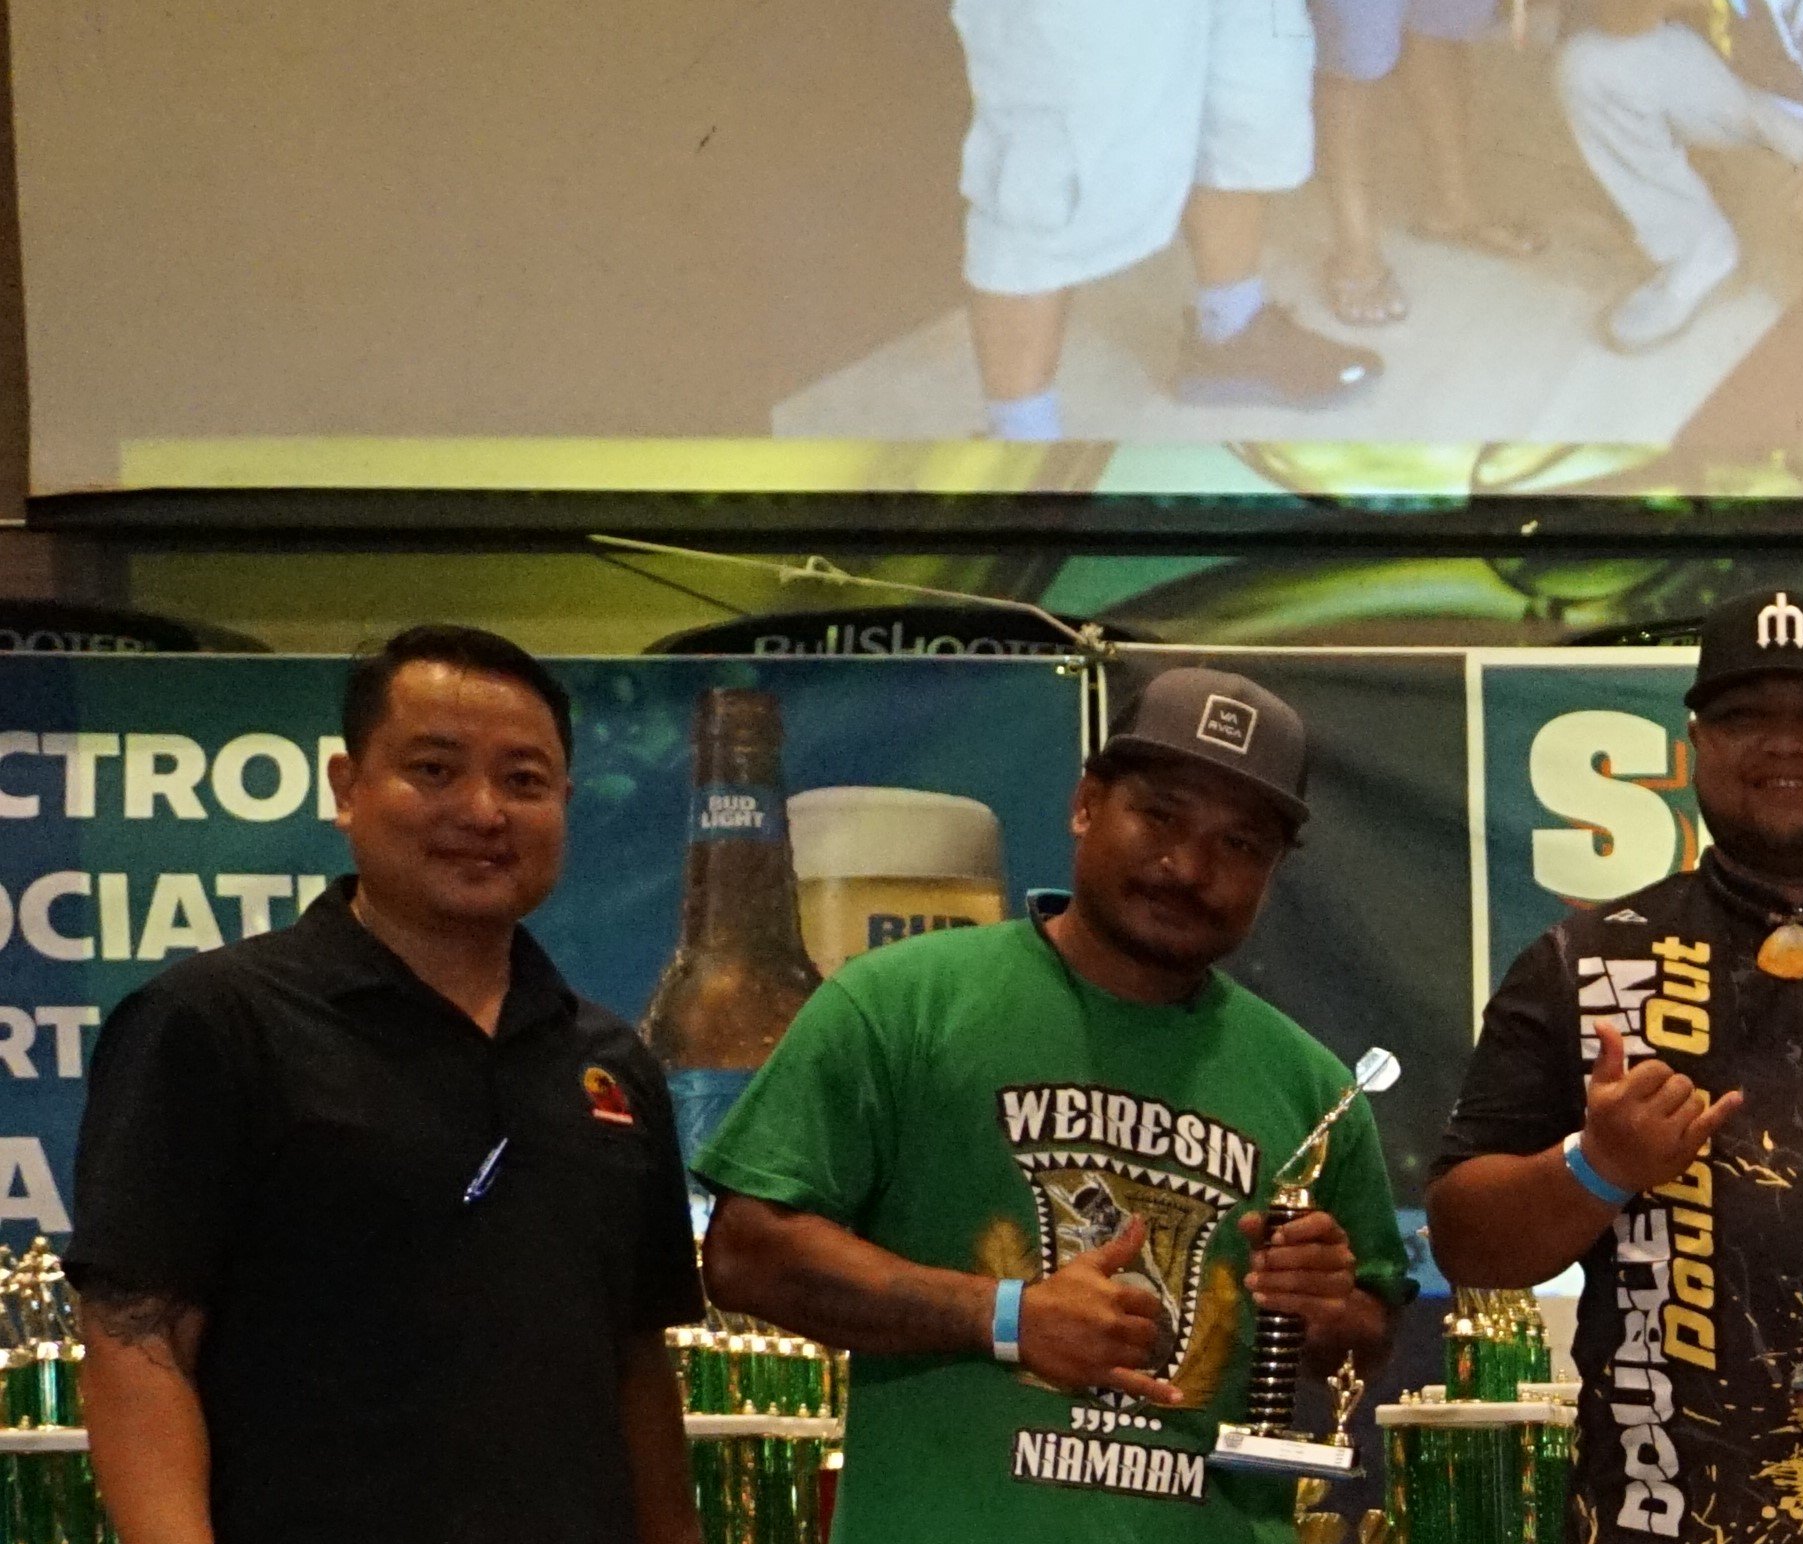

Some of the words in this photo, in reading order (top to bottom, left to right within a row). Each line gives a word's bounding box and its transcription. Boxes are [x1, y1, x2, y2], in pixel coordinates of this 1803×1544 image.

[701, 811, 765, 829] LIGHT
[708, 795, 757, 812] BUD
[1645, 936, 1711, 1055] Out
[1002, 1087, 1257, 1197] WEIRESIN
[1610, 1207, 1686, 1539] DOUBLE
